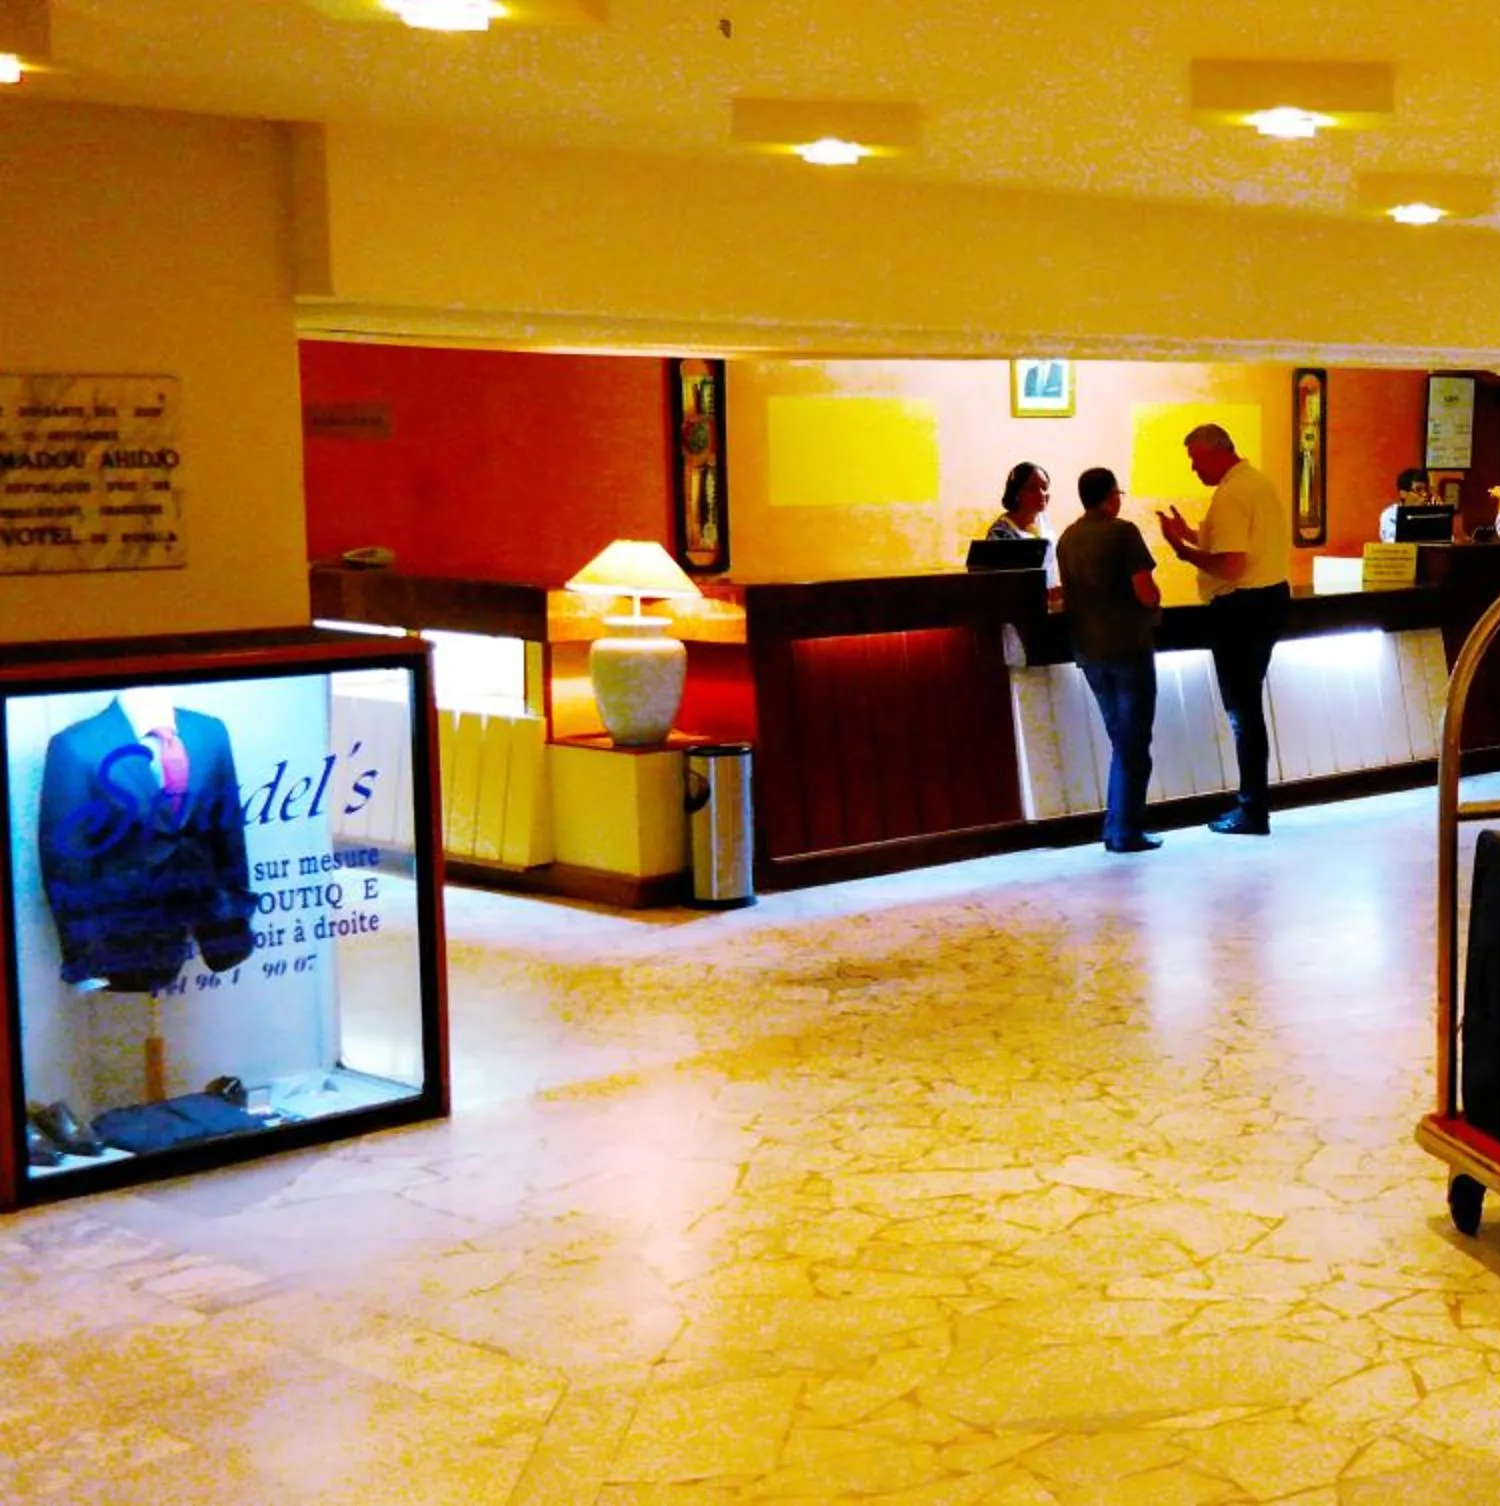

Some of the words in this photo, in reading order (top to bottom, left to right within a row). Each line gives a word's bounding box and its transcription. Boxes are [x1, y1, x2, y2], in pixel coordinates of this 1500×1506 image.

[253, 858, 291, 882] sur
[299, 847, 380, 876] mesure
[292, 918, 308, 949] à
[313, 911, 380, 940] droite
